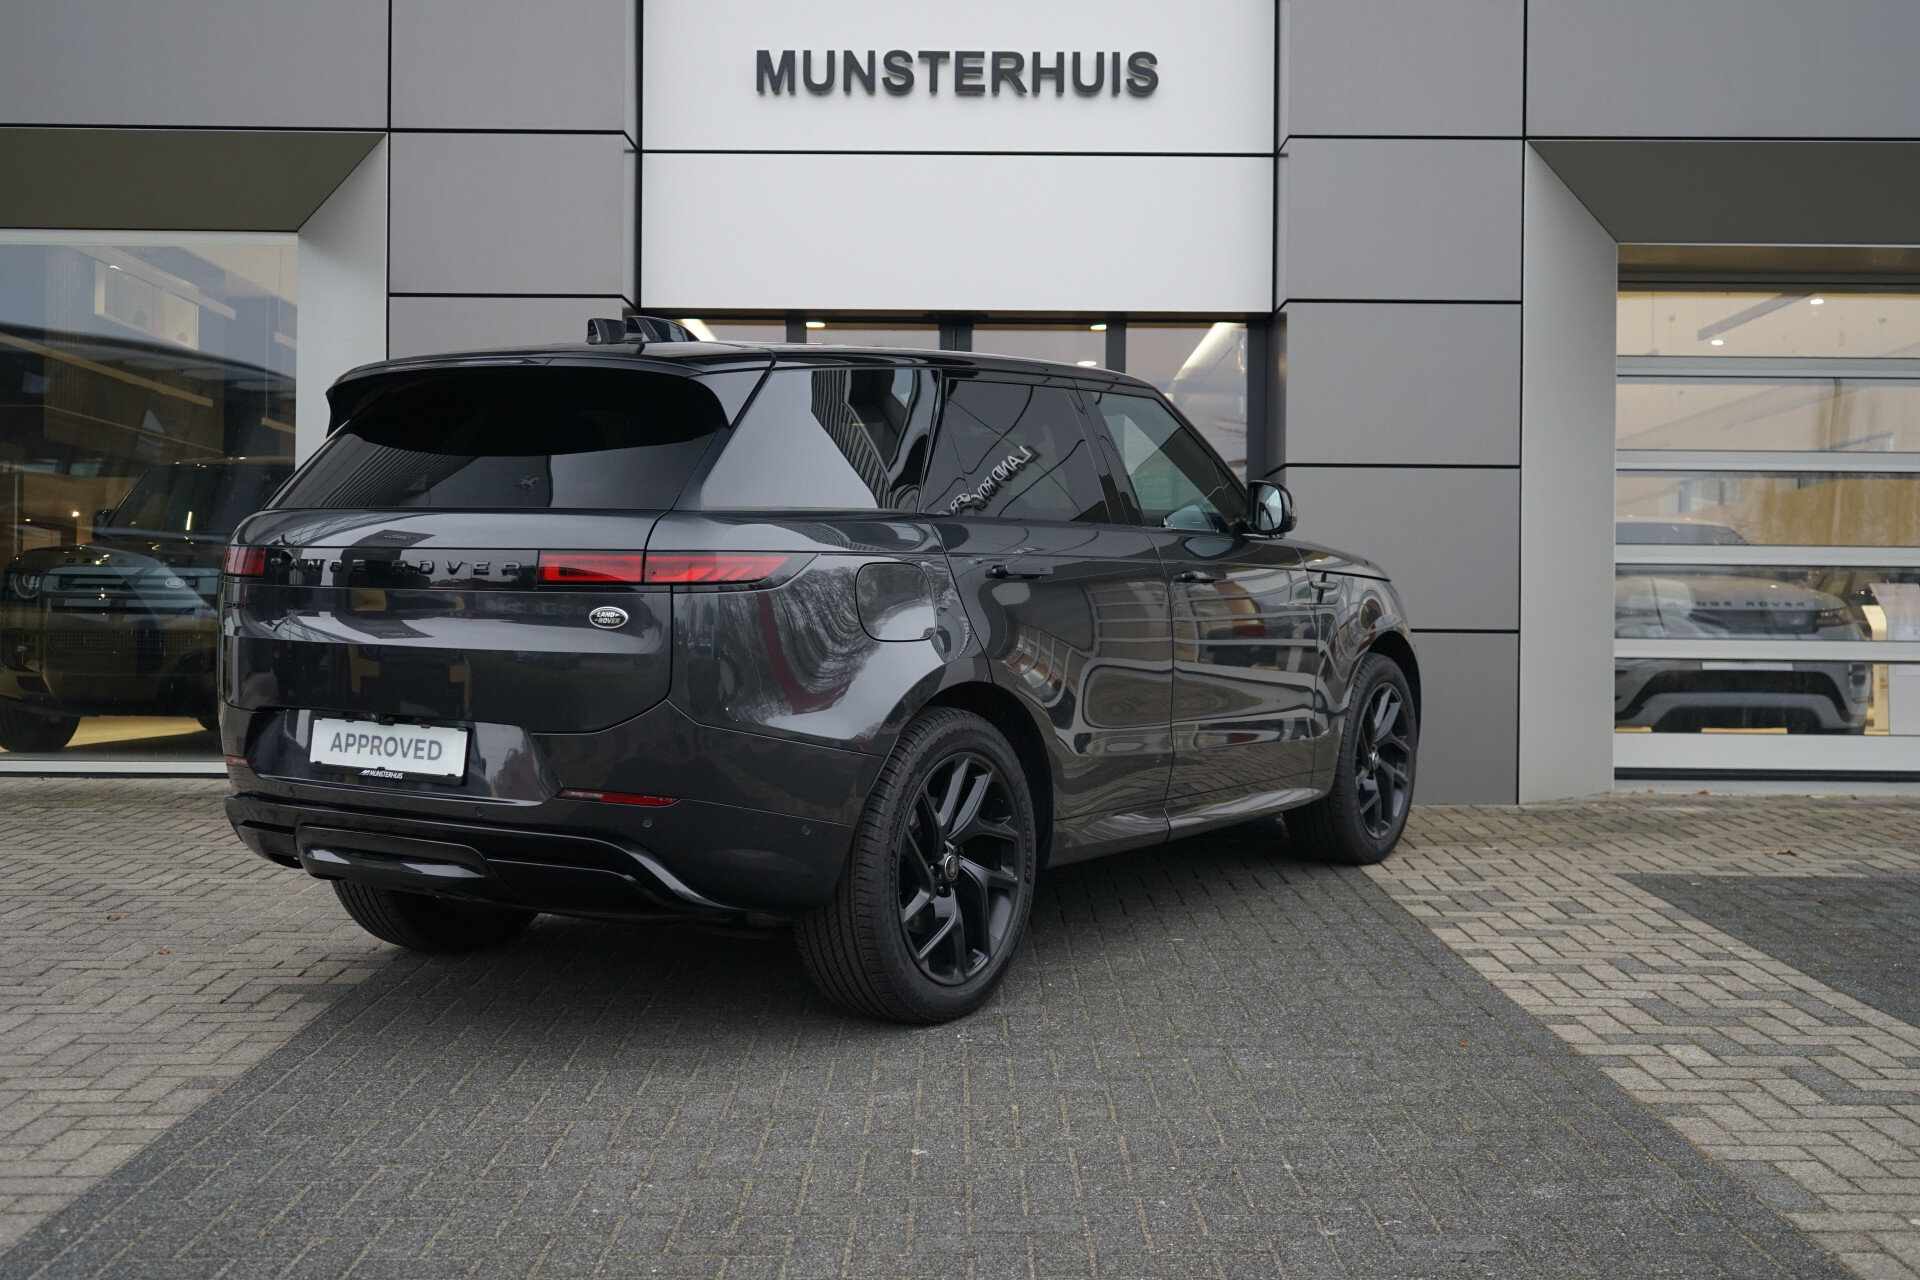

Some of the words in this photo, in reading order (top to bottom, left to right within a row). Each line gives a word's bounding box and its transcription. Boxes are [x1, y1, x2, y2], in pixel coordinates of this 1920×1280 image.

[756, 49, 1160, 97] MUNSTERHUIS
[391, 559, 521, 576] ROVER
[330, 732, 443, 761] APPROVED
[369, 769, 404, 780] MUNSTERHUIS
